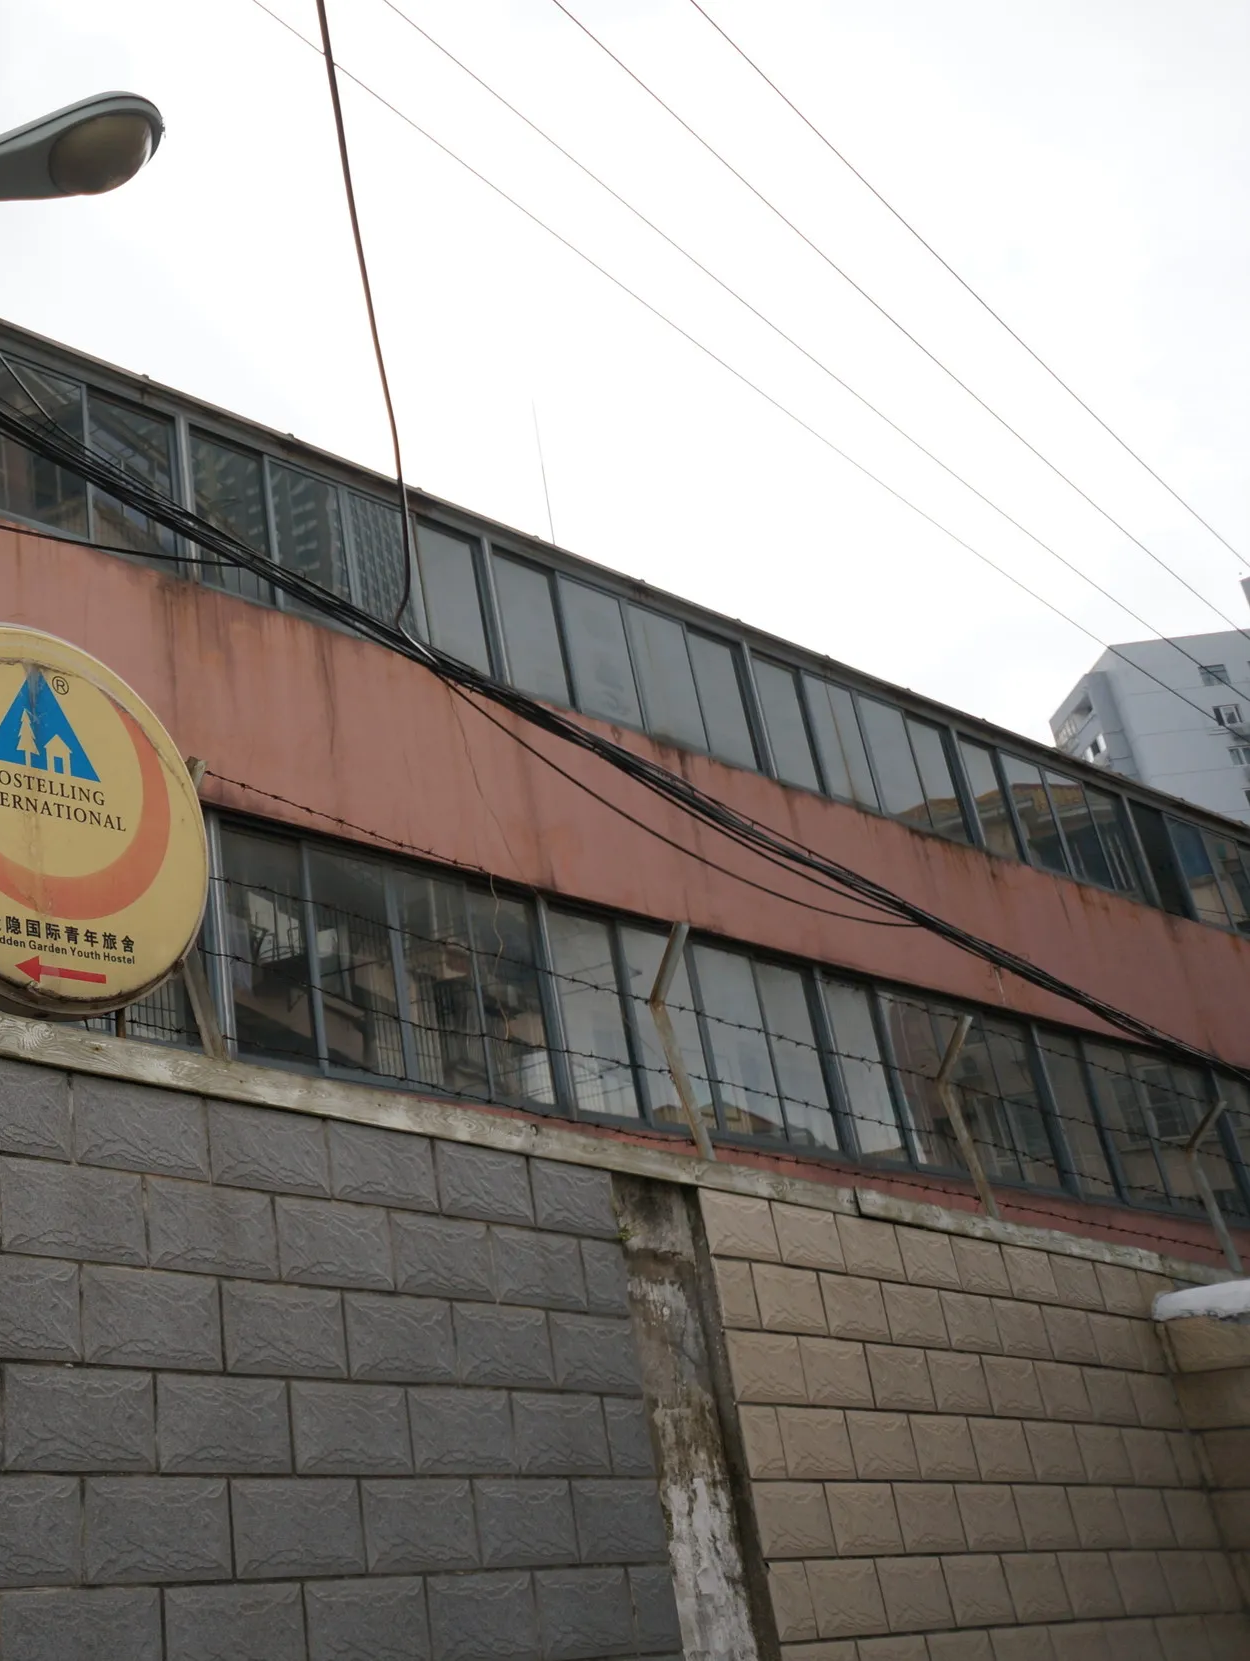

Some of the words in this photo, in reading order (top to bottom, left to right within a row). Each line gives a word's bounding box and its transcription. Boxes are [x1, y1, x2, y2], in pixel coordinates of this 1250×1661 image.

[28, 940, 67, 955] Garden
[70, 947, 101, 960] Youth
[103, 952, 135, 964] Hostel
